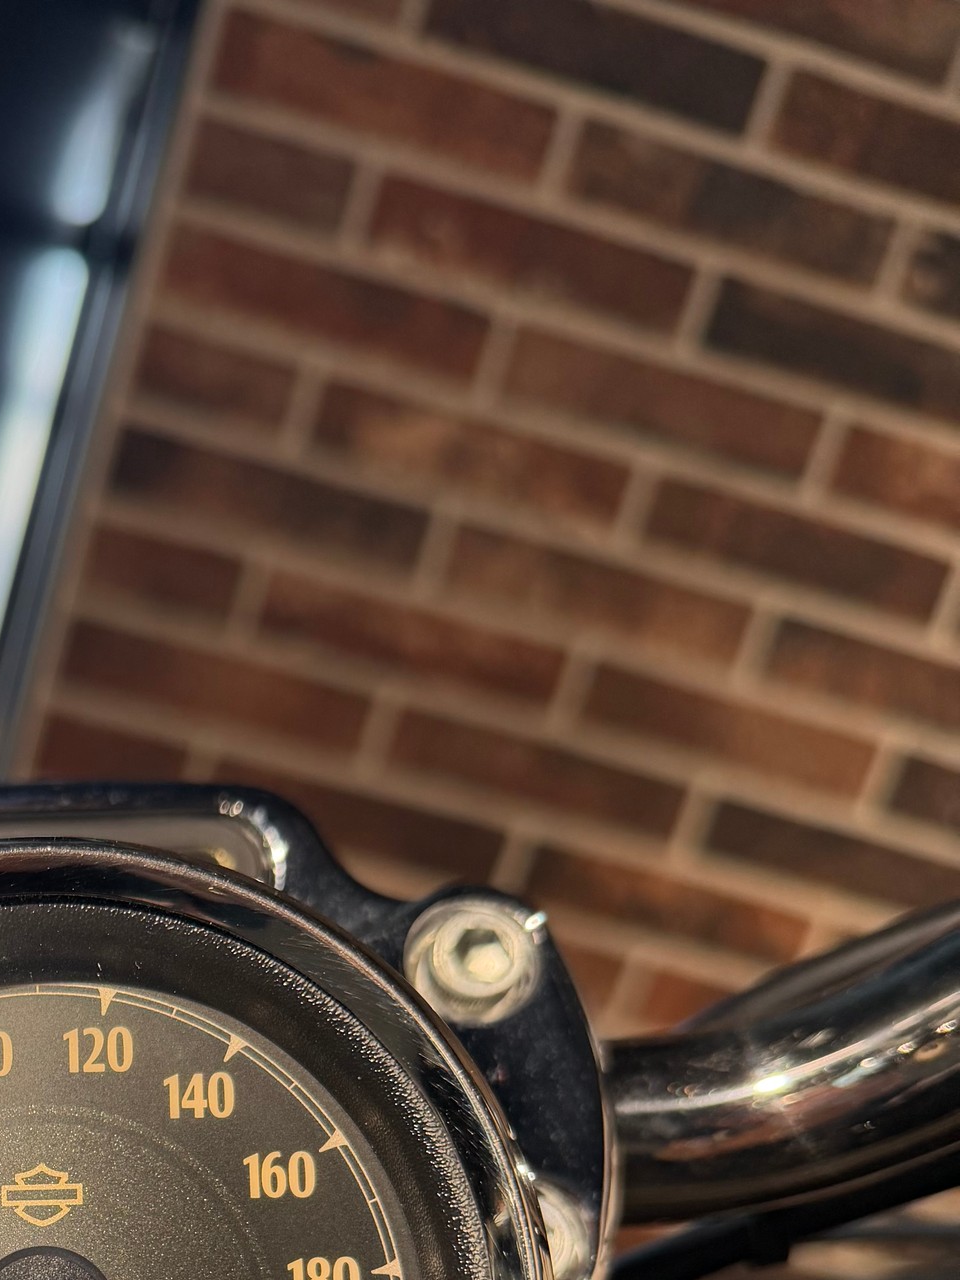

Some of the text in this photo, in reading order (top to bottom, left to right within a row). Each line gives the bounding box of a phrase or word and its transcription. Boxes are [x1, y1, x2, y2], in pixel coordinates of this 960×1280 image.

[63, 1026, 133, 1074] 120
[163, 1072, 235, 1119] 140
[243, 1151, 316, 1199] 160
